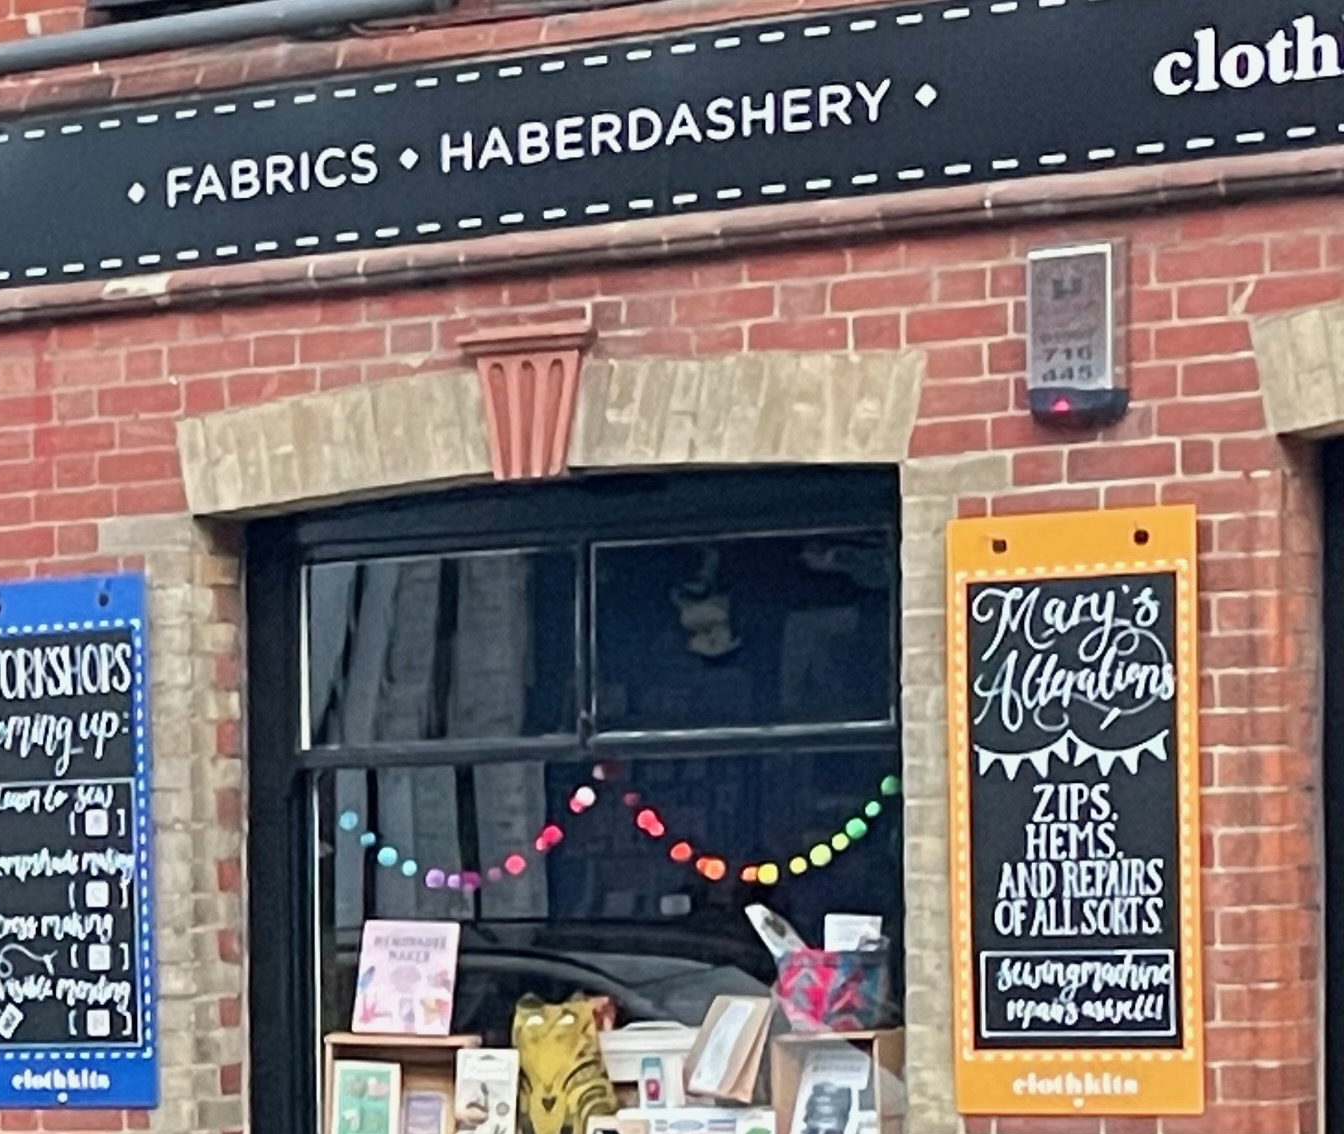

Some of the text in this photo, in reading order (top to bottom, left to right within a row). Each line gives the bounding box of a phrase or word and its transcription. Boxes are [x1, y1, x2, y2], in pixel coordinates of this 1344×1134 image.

[1153, 14, 1344, 96] cloth
[165, 78, 893, 208] FABRICS HABERDASHERY
[971, 584, 1160, 663] Mary's
[973, 646, 1176, 733] Alterations
[998, 857, 1164, 898] AND REPAIRS
[994, 899, 1029, 937] OF
[1029, 898, 1079, 937] ALL
[11, 1068, 111, 1091] clothkits
[1011, 1071, 1139, 1095] clothkits
